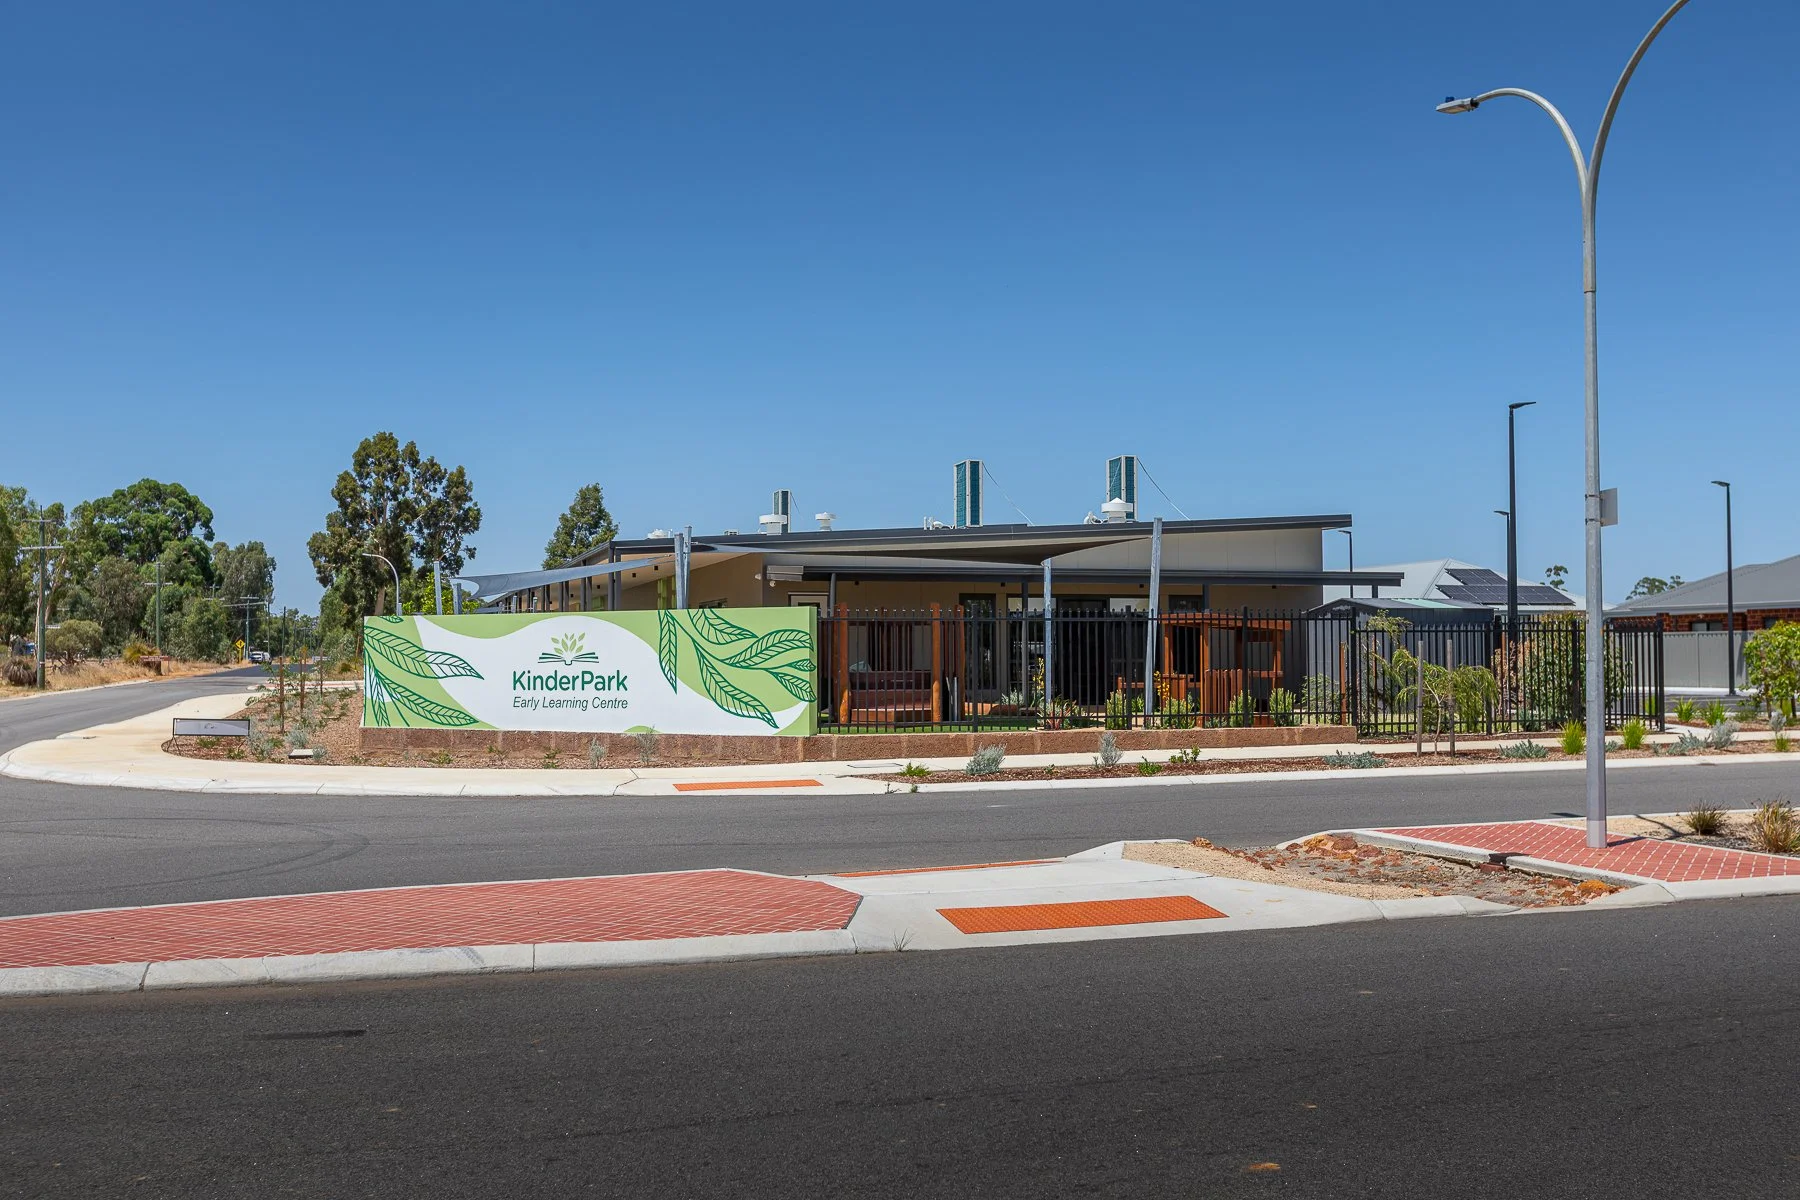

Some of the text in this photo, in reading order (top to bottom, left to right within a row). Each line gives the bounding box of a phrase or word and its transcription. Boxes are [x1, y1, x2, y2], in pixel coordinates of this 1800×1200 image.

[512, 669, 628, 692] KinderPark
[513, 696, 628, 711] Early Learning Centre
